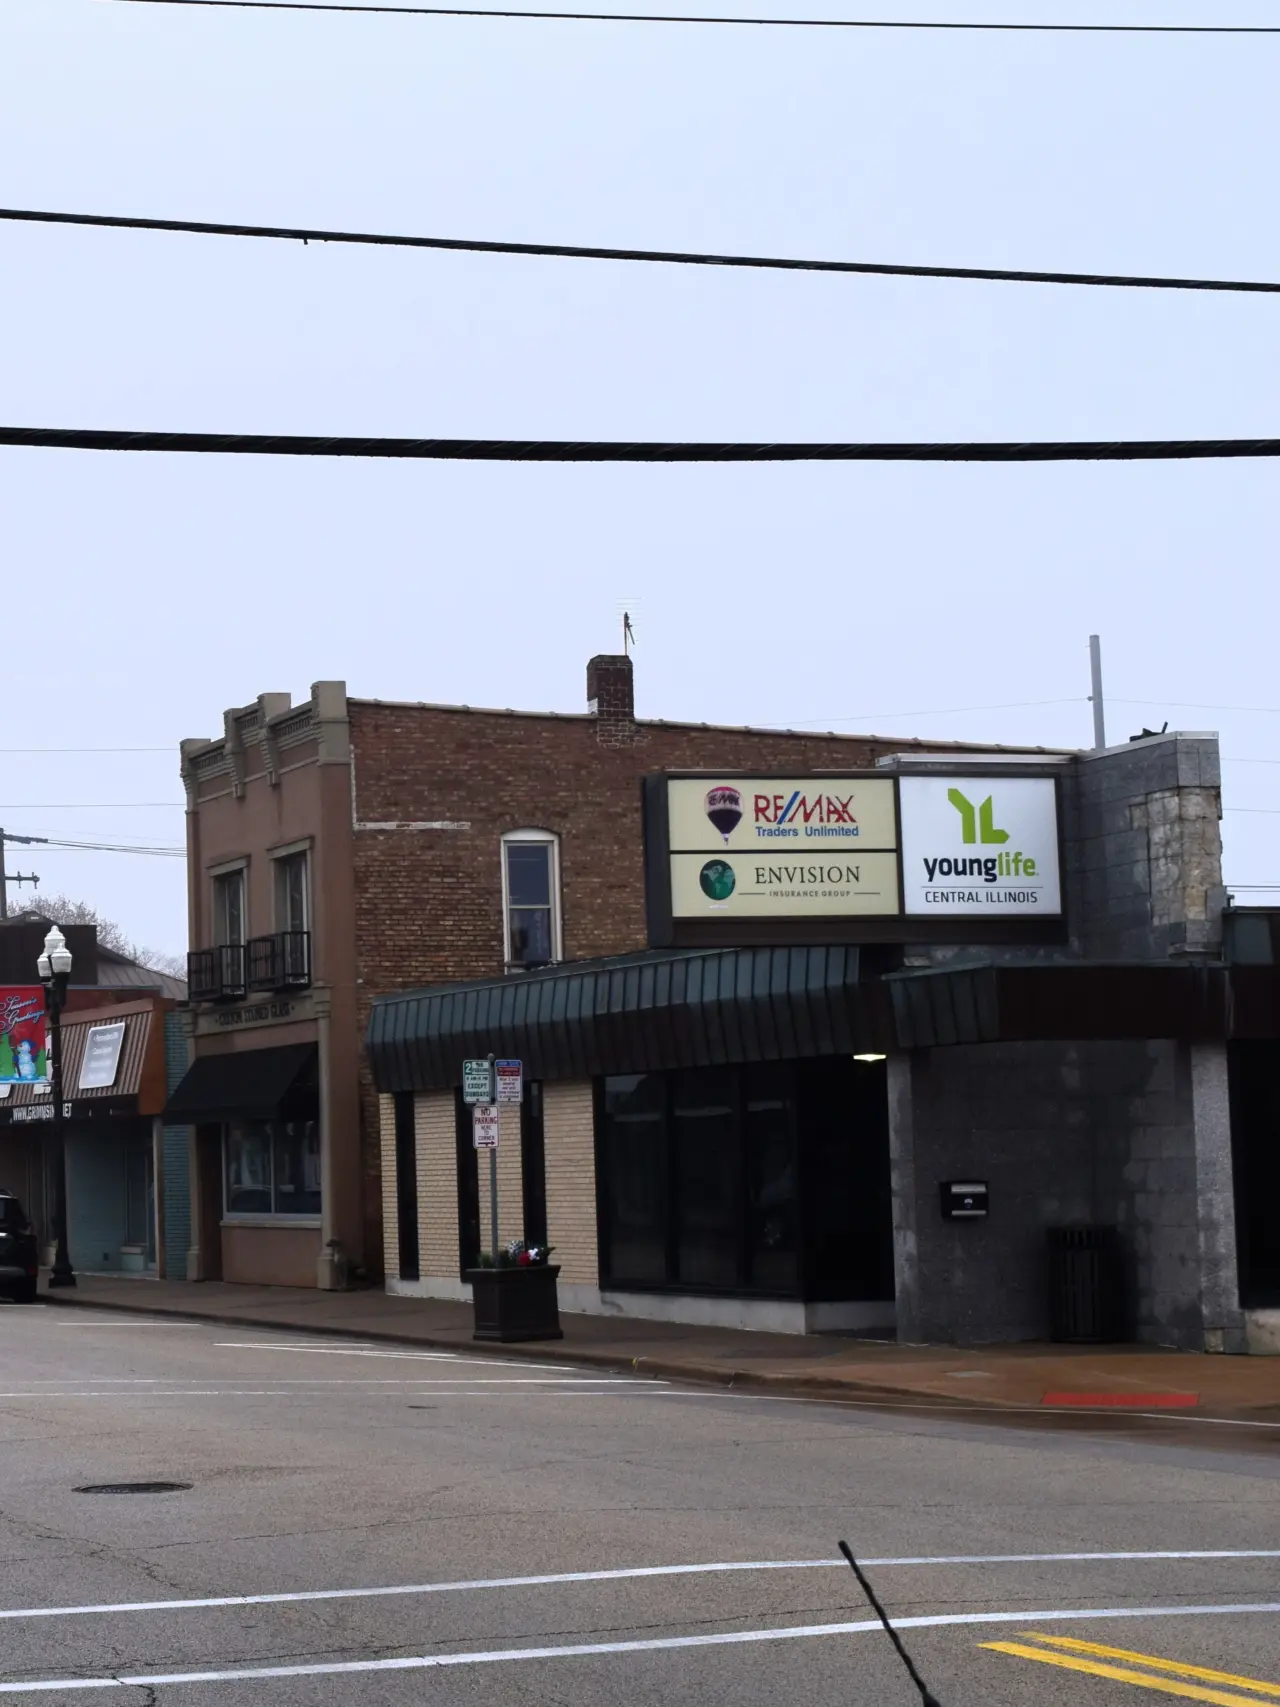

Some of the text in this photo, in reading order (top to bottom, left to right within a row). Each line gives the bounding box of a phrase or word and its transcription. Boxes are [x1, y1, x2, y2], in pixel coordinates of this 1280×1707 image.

[753, 791, 857, 825] RE/MAX
[755, 826, 859, 837] Traders Unlimited
[755, 865, 861, 884] ENVISION
[925, 891, 1038, 903] CENTRAL ILLINOIS
[271, 1002, 291, 1018] GLASS
[465, 1062, 472, 1073] 2
[481, 1108, 490, 1116] NO
